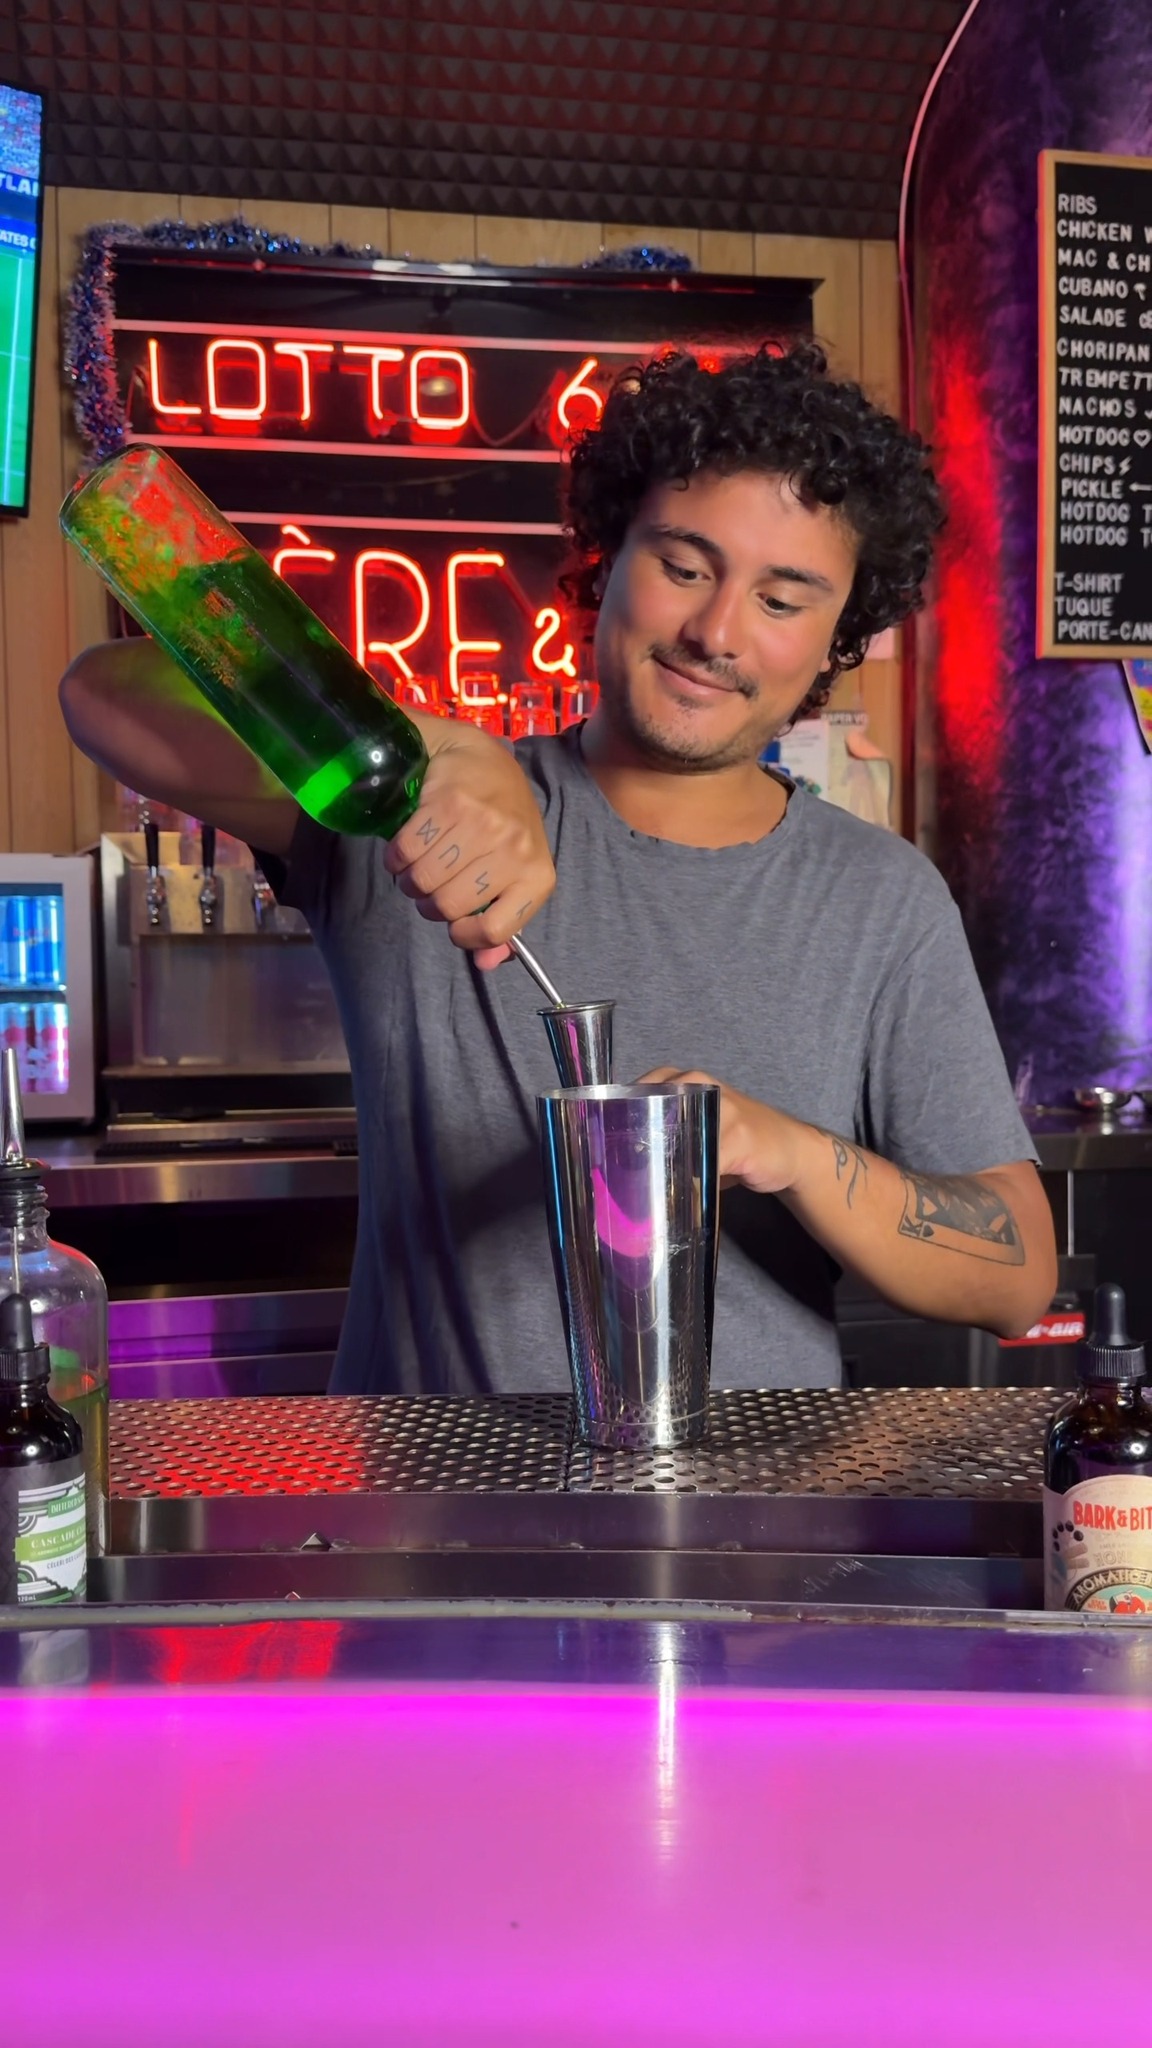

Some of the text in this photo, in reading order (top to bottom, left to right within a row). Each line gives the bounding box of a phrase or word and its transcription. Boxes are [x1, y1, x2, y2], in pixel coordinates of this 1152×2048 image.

[1058, 194, 1097, 215] RIBS
[1057, 219, 1132, 242] CHICKEN
[1058, 248, 1150, 273] MAC & CH
[1059, 276, 1128, 298] CUBANO
[1060, 305, 1127, 328] SALADE
[1057, 338, 1150, 362] CHORIPAN
[150, 339, 470, 430] LOTTO
[1059, 397, 1136, 418] NACHOS
[1059, 425, 1130, 446] HOTDOG
[1060, 453, 1116, 475] CHIPS
[1062, 478, 1123, 499] PICKLE
[1061, 501, 1130, 523] HOTDOG
[1061, 525, 1128, 547] HOTDOG
[1055, 572, 1123, 594] T-SHIRT
[1056, 596, 1113, 617] TUQUE
[532, 607, 577, 678] &
